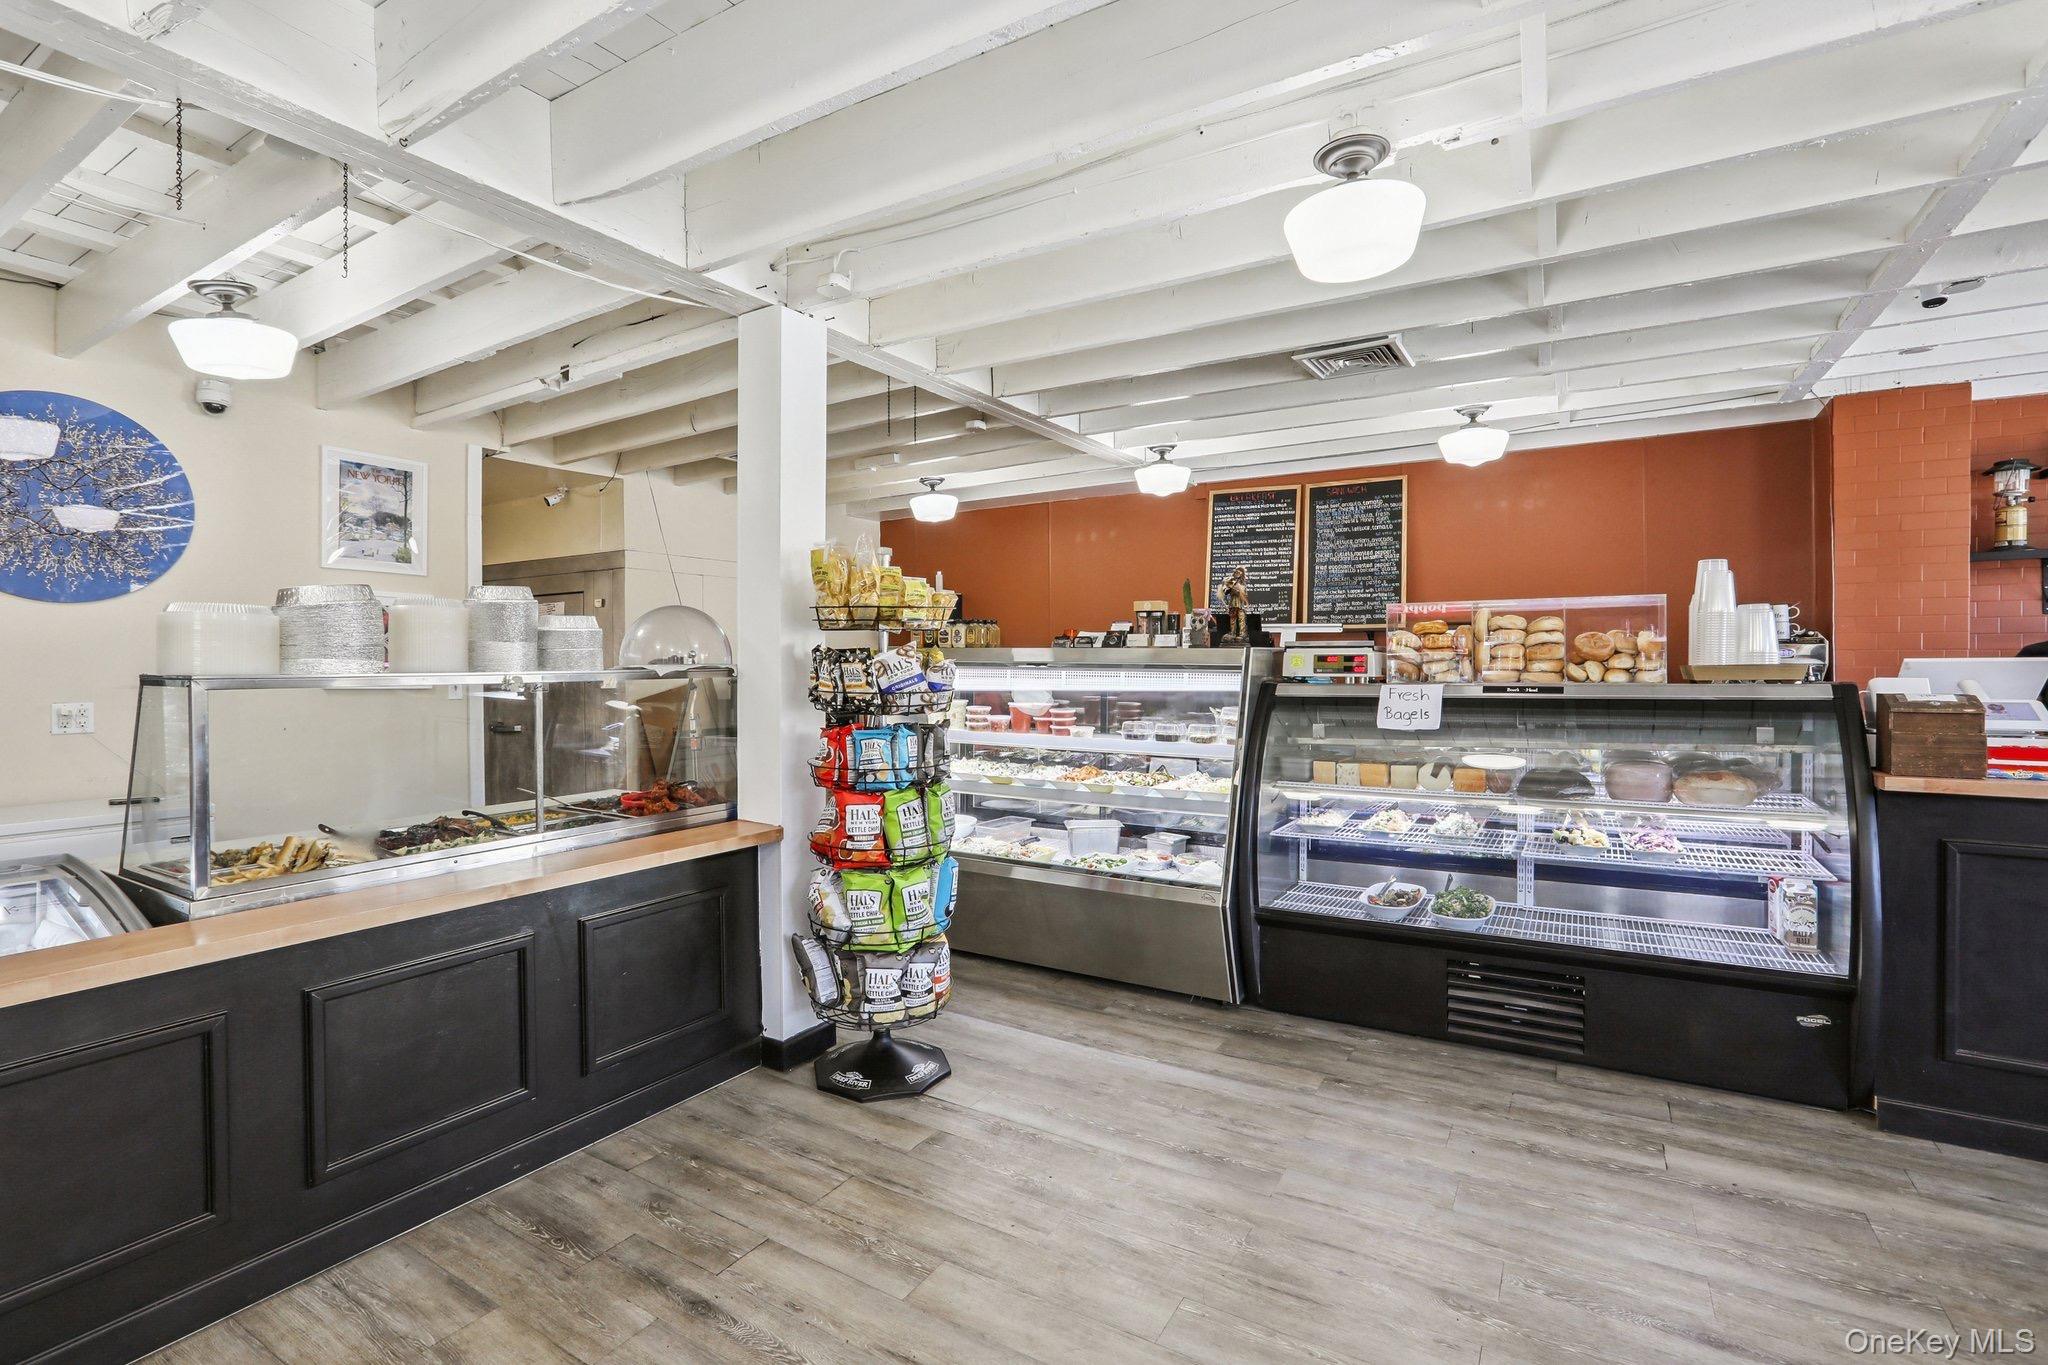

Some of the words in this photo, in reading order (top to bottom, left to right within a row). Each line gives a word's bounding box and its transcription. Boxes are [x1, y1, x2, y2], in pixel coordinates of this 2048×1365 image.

[347, 469, 370, 480] NEW
[885, 659, 914, 677] HAL'S
[891, 677, 919, 691] ORIGINALS
[1389, 687, 1430, 701] Fresh
[1383, 705, 1430, 727] Bagels
[850, 808, 880, 821] HAL'S
[902, 804, 924, 818] HAL
[850, 893, 877, 907] HAL'S
[868, 972, 898, 985] HAL'S
[848, 1080, 869, 1088] RIVER
